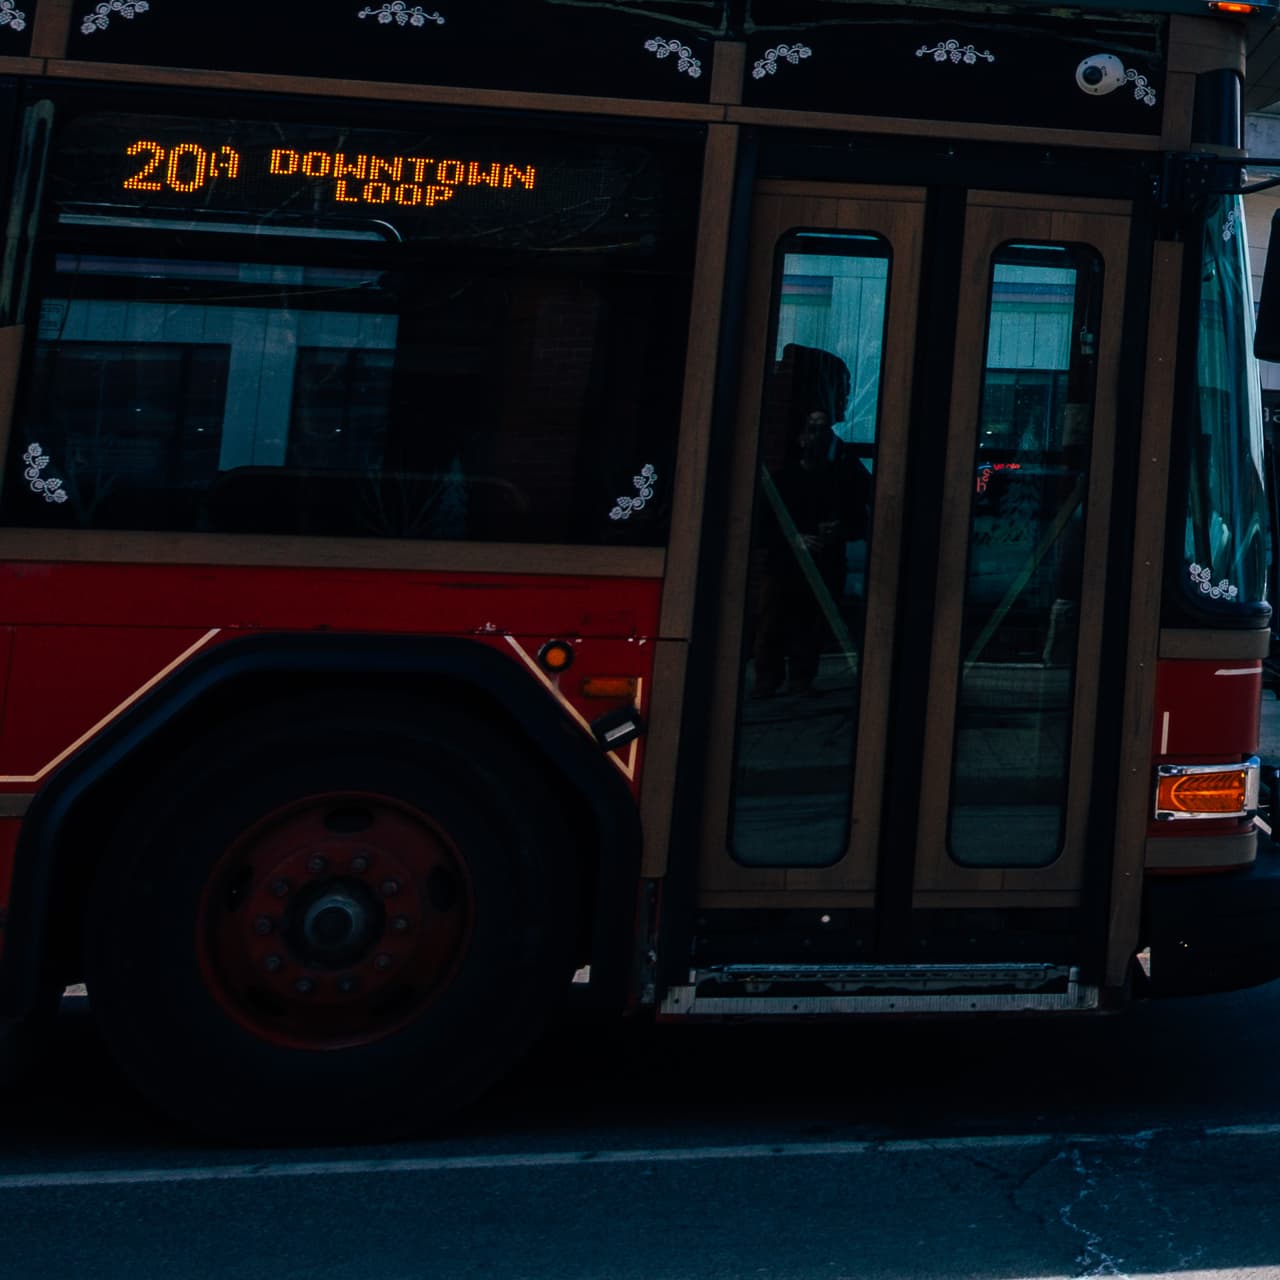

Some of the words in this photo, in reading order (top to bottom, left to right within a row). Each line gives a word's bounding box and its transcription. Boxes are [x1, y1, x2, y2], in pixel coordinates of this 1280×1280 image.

[123, 141, 239, 193] 20A
[269, 148, 536, 190] DOWNTOWN
[335, 179, 454, 206] LOOP
